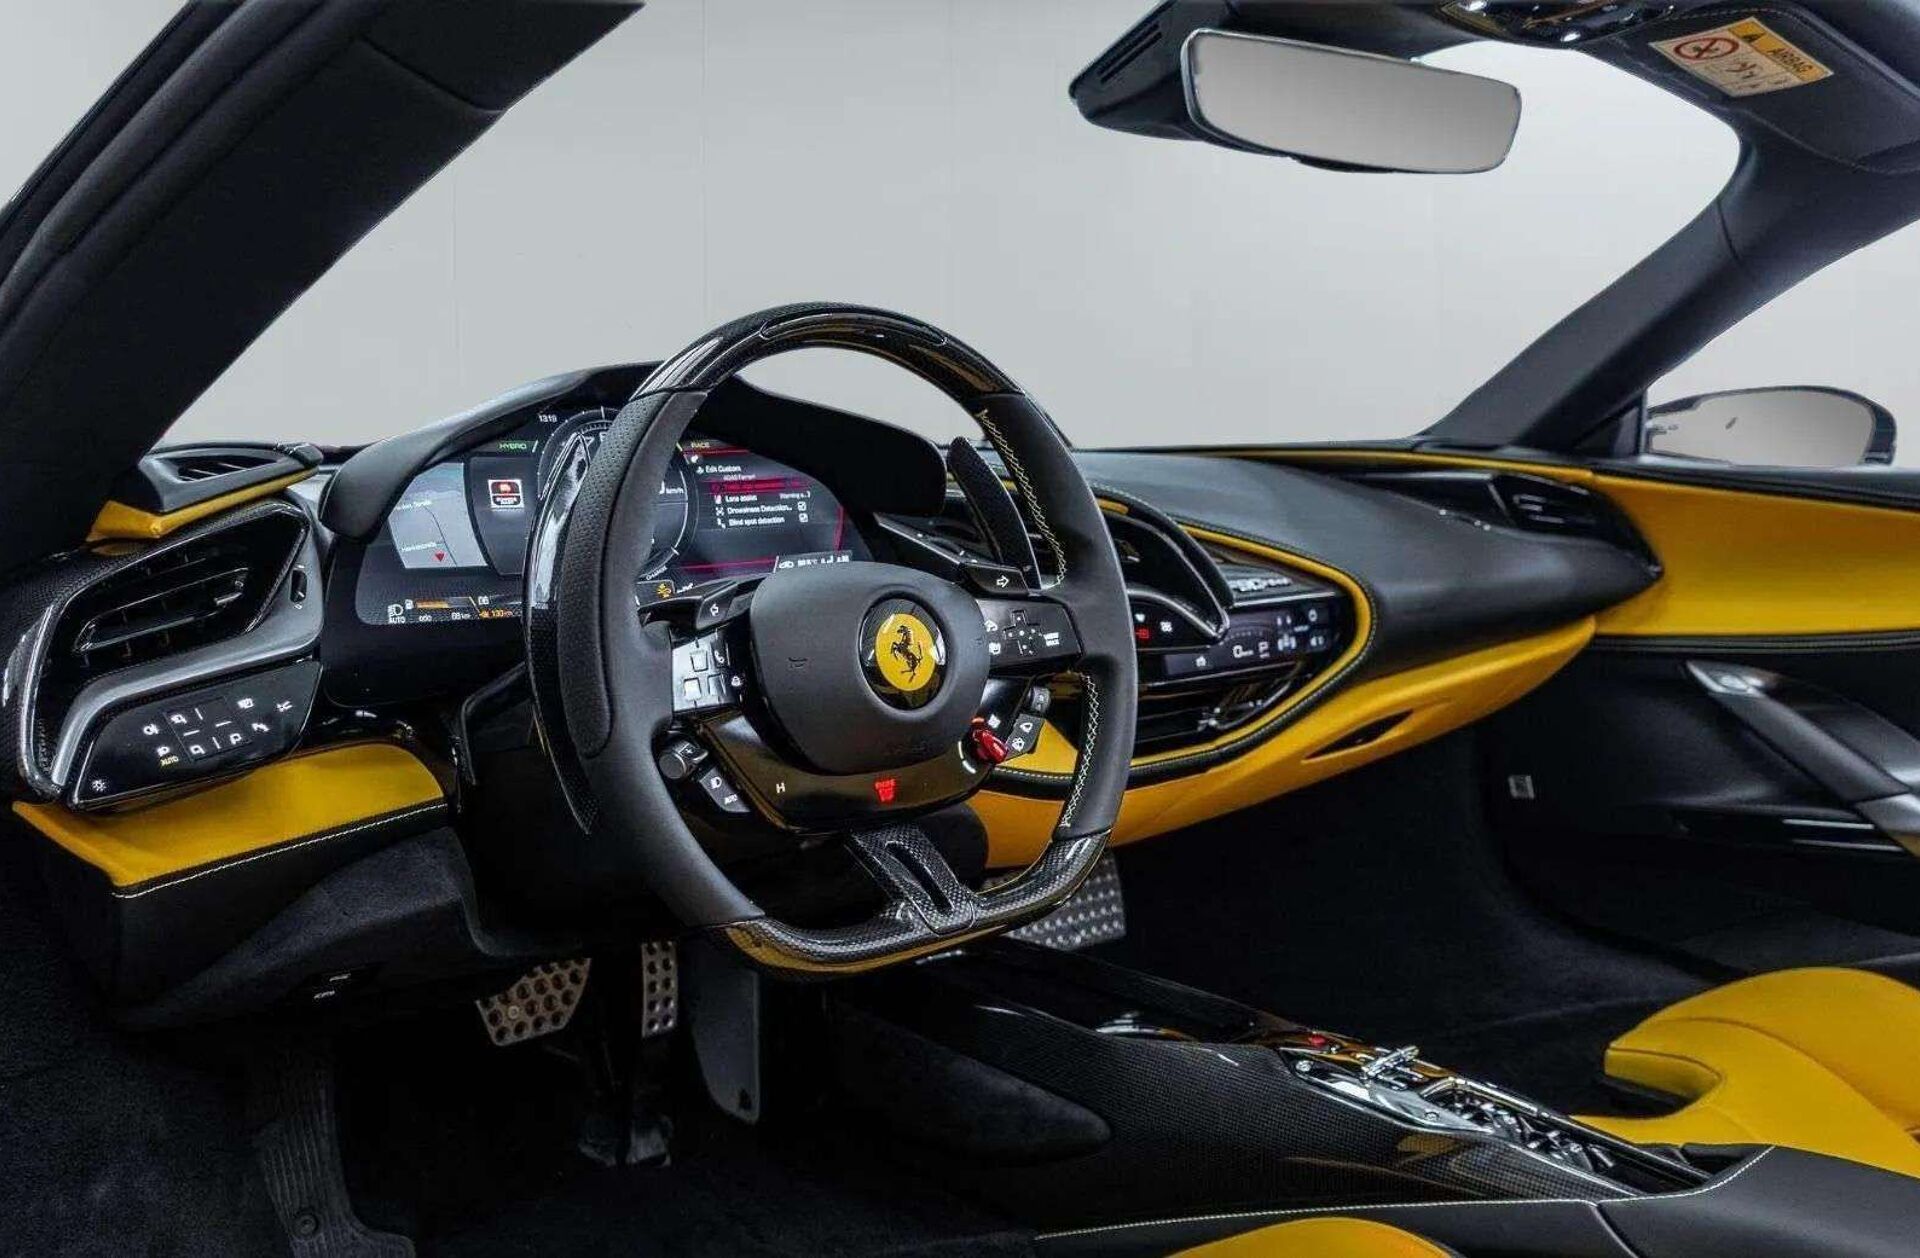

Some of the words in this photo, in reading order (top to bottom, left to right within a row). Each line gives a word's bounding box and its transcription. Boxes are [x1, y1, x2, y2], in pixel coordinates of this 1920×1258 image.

[500, 442, 527, 450] HYBRID
[705, 465, 717, 473] Edit
[718, 465, 741, 473] Custom
[725, 495, 740, 503] Lane
[727, 506, 761, 514] Drowsiness
[729, 518, 743, 526] Blind
[744, 518, 757, 526] spot
[758, 516, 785, 525] detection
[160, 755, 179, 767] AUTO
[775, 782, 786, 794] H
